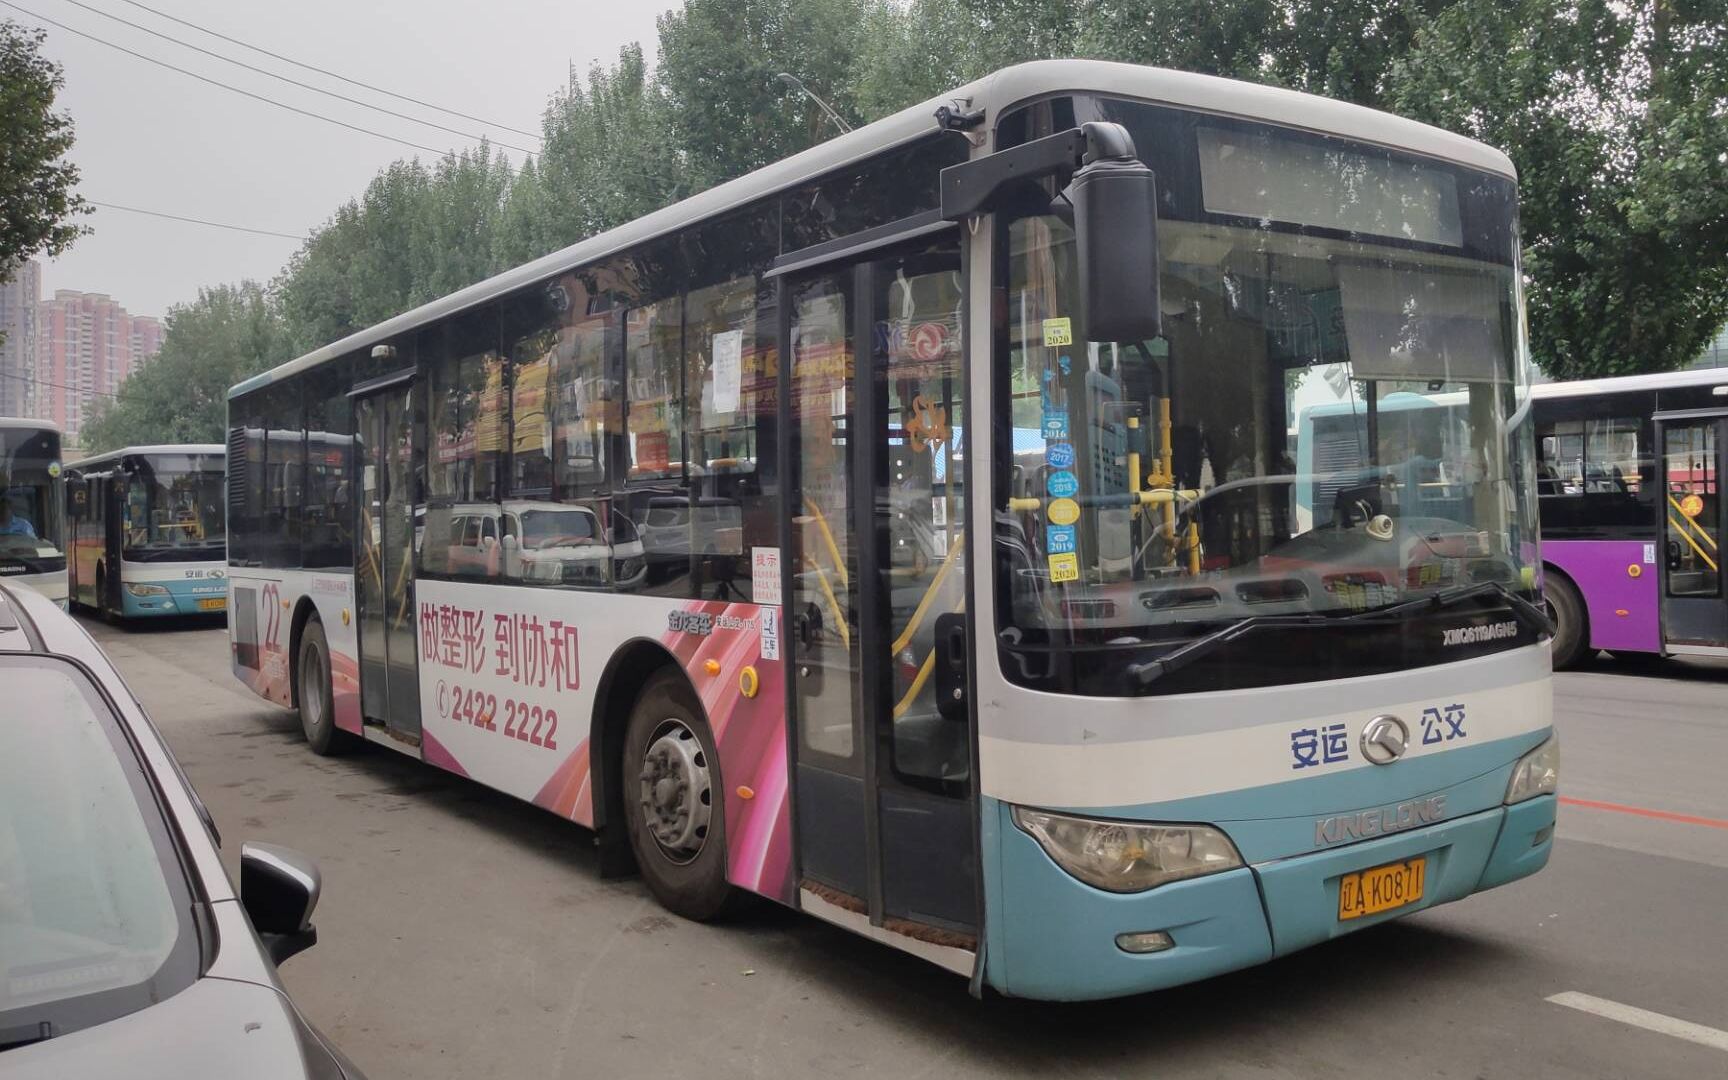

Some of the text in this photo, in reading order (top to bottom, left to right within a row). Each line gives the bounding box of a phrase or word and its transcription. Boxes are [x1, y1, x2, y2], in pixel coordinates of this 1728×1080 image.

[1048, 336, 1069, 345] 2020
[1043, 429, 1067, 438] 2016
[1050, 452, 1070, 463] 2017
[1050, 541, 1073, 552] 2019
[262, 583, 282, 653] 22
[1443, 621, 1517, 646] XMQ6119AGN5
[420, 602, 580, 692] 做整形 到协和
[452, 686, 558, 750] 2422 2222
[1291, 703, 1467, 769] 安运 公交
[1314, 795, 1448, 847] KING LONG
